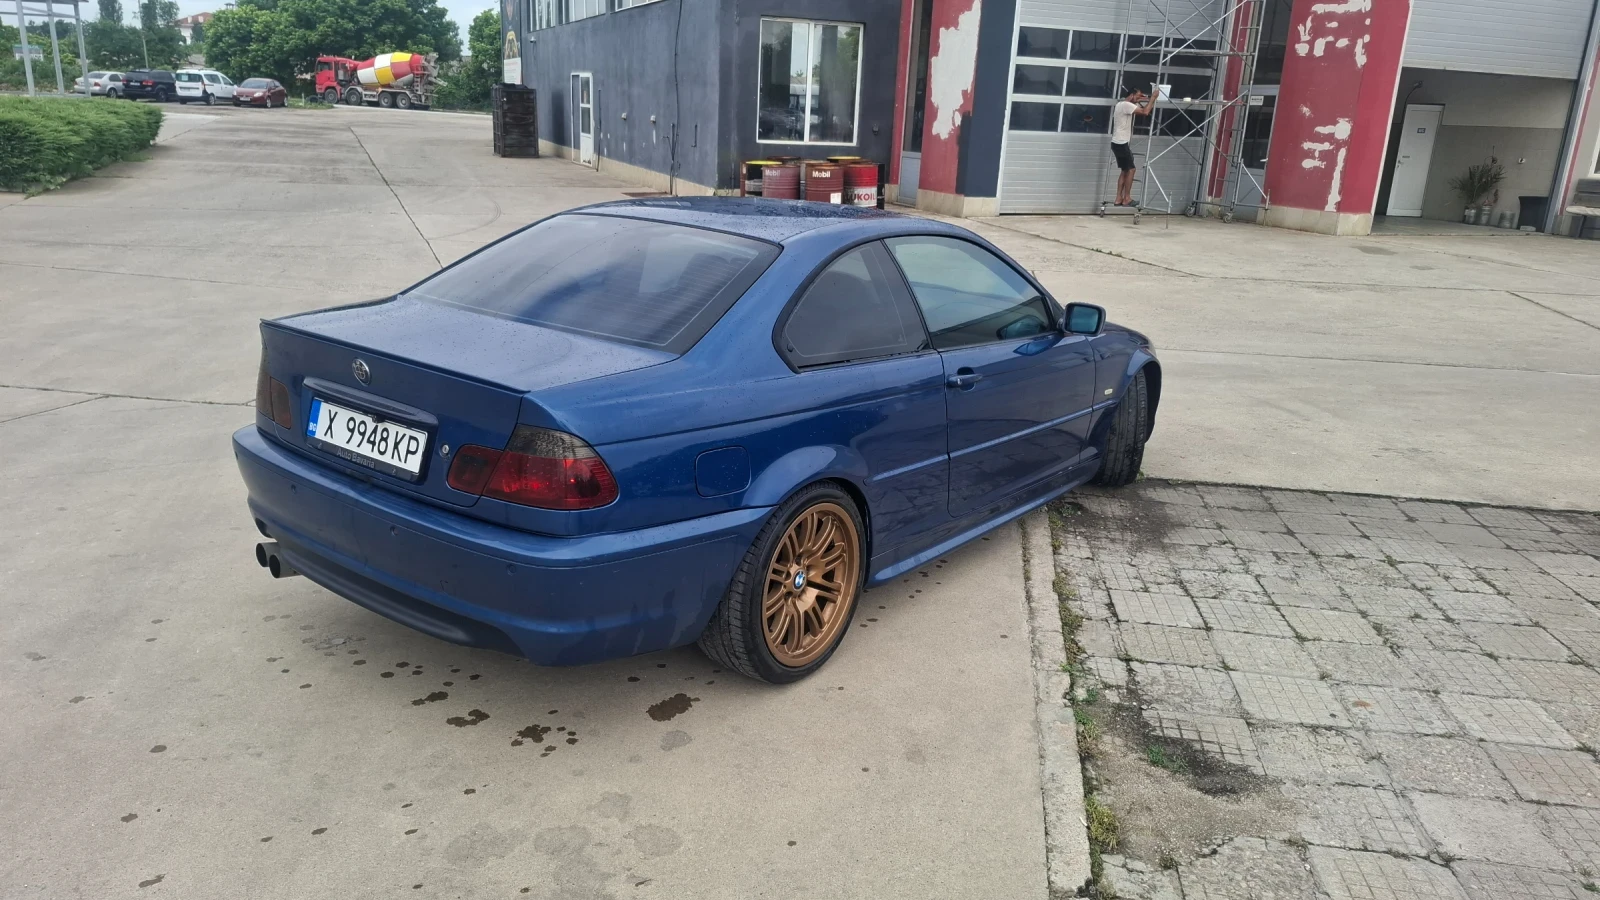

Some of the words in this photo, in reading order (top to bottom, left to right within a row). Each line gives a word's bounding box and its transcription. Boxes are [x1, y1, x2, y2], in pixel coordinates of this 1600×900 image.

[812, 170, 831, 178] Mobil
[323, 409, 339, 439] X
[336, 447, 352, 460] Auto
[351, 452, 375, 469] Bavaria
